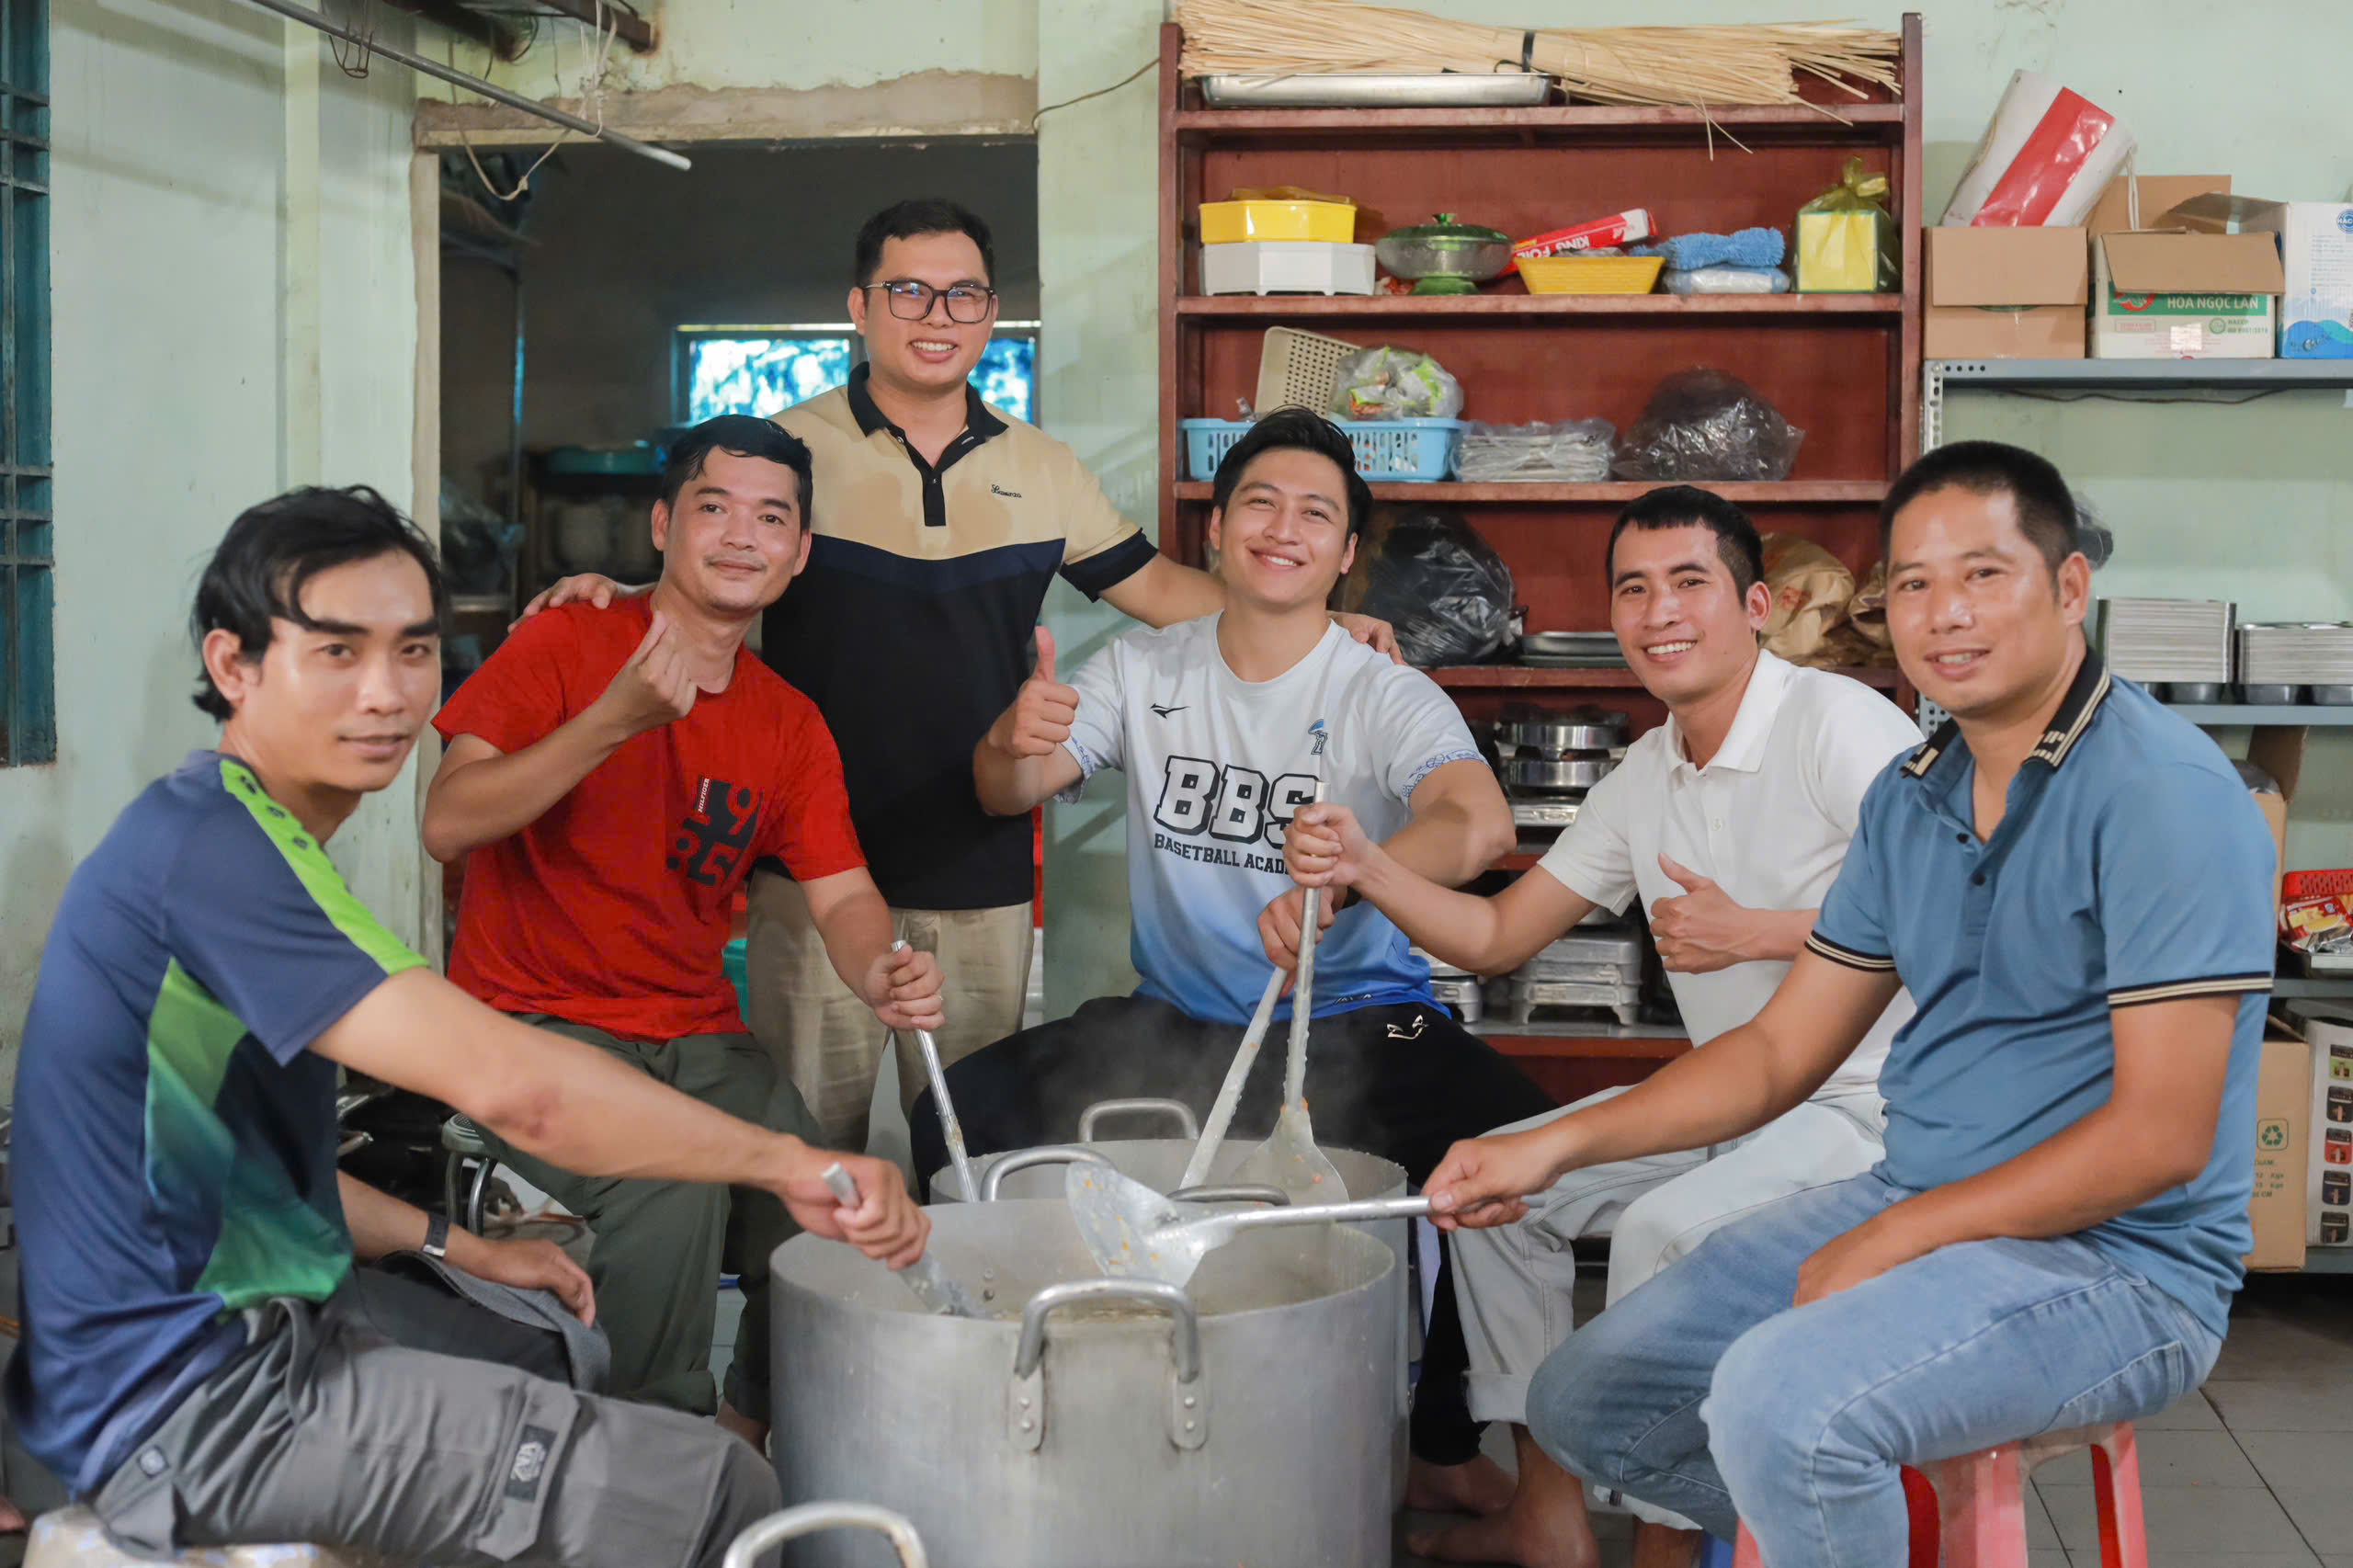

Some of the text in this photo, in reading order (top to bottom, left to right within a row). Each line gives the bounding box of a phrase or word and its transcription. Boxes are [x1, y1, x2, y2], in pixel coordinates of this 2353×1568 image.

[1517, 235, 1590, 258] KING FOIL
[2167, 296, 2258, 312] HOA NGỌC LAN
[698, 778, 710, 813] HILFIGER
[1153, 755, 1320, 849] BBS
[1154, 833, 1289, 876] BASETBALL ACAD
